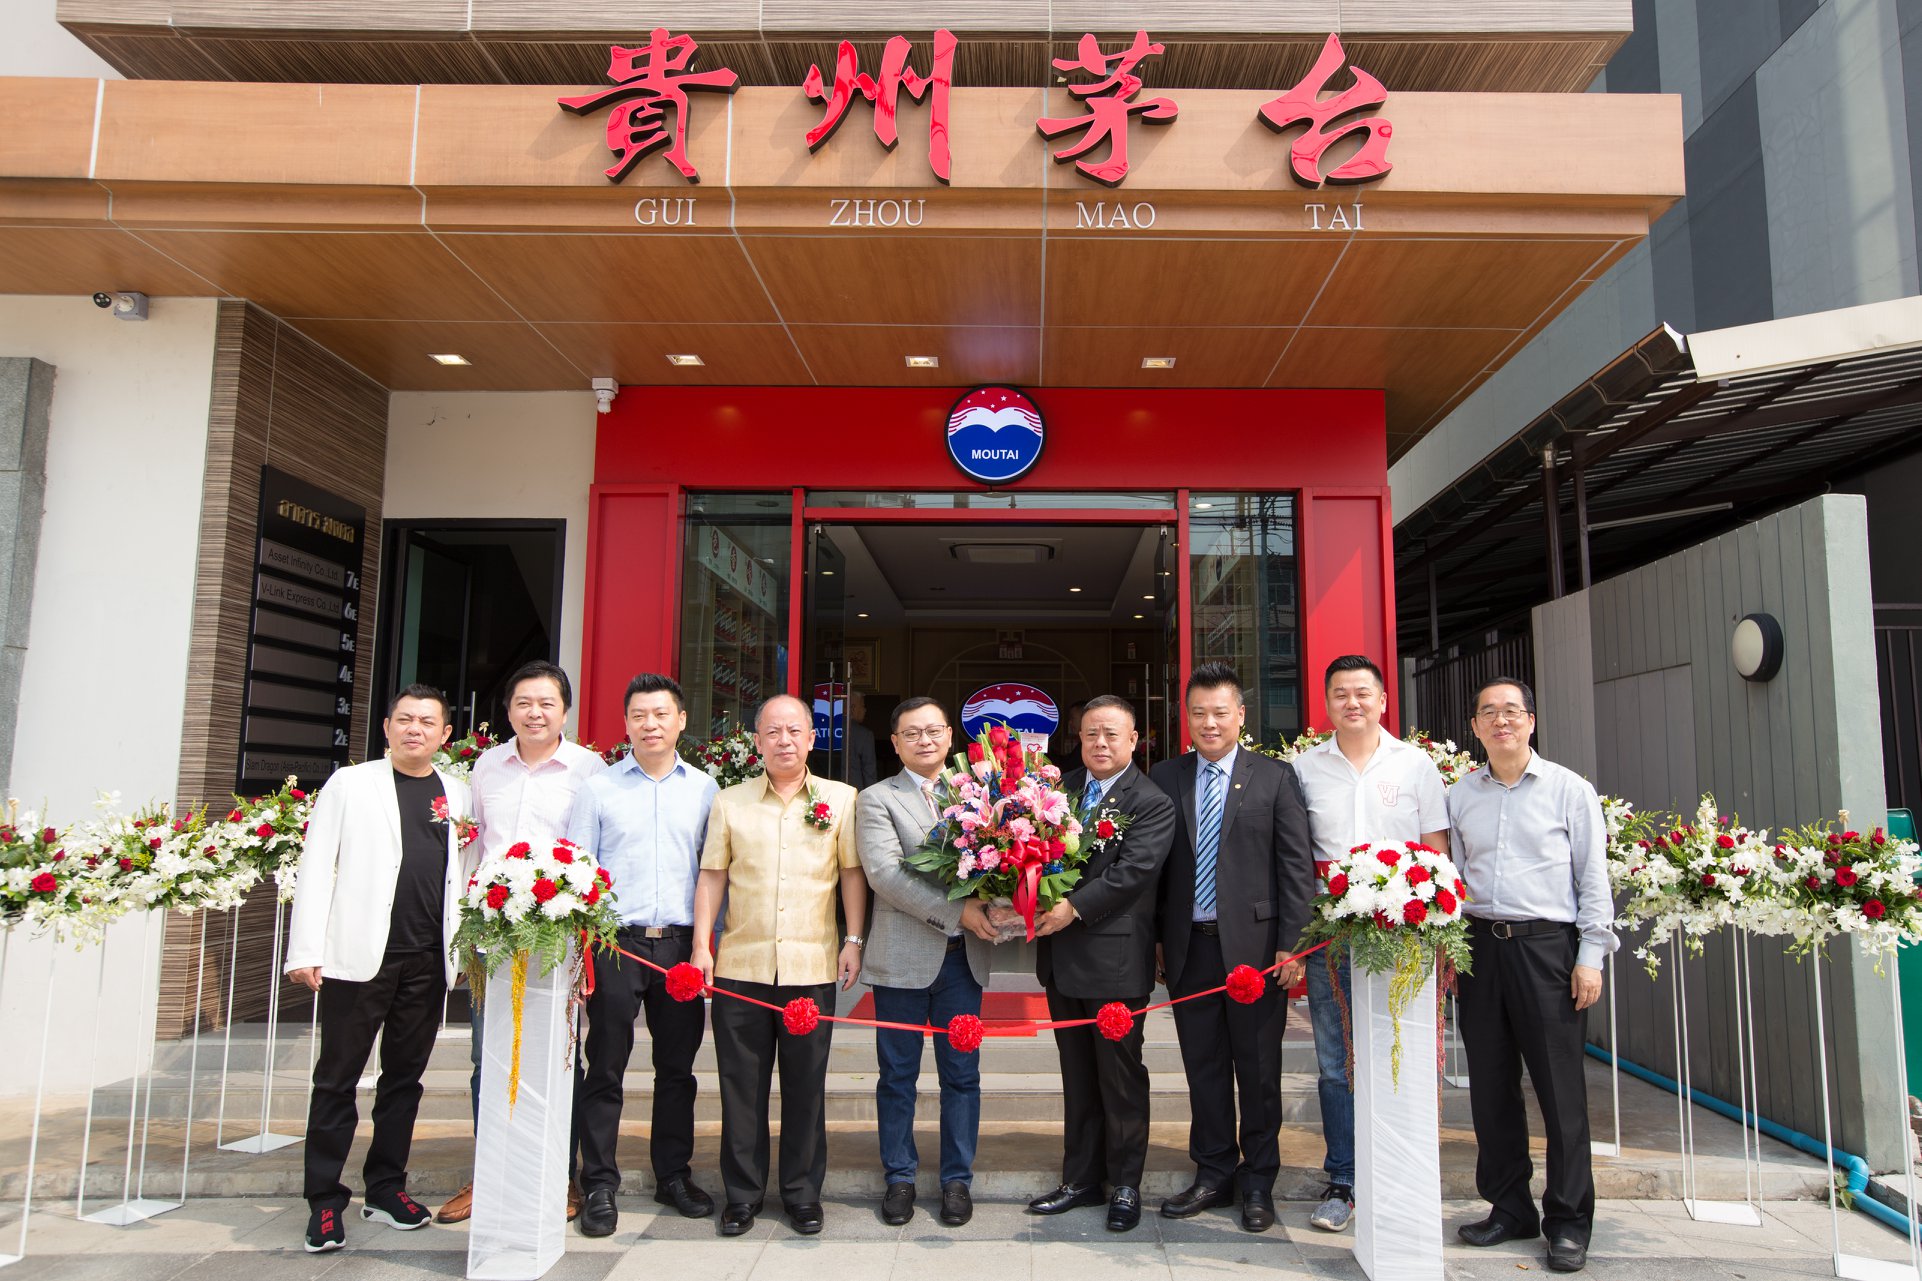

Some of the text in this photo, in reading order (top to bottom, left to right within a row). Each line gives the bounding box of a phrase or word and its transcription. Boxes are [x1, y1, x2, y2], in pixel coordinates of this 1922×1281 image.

[634, 199, 1366, 231] GUI ZHOU MAO TAI
[971, 449, 1019, 460] MOUTAI
[268, 548, 289, 565] Asset
[290, 555, 314, 575] Infinity
[347, 571, 359, 590] 7E
[261, 582, 285, 599] V-Link
[286, 588, 315, 607] Express
[344, 602, 357, 621] 6E
[341, 633, 355, 652] 5E
[340, 665, 353, 683] 4E
[337, 697, 351, 715] 3E
[334, 728, 348, 746] 2E
